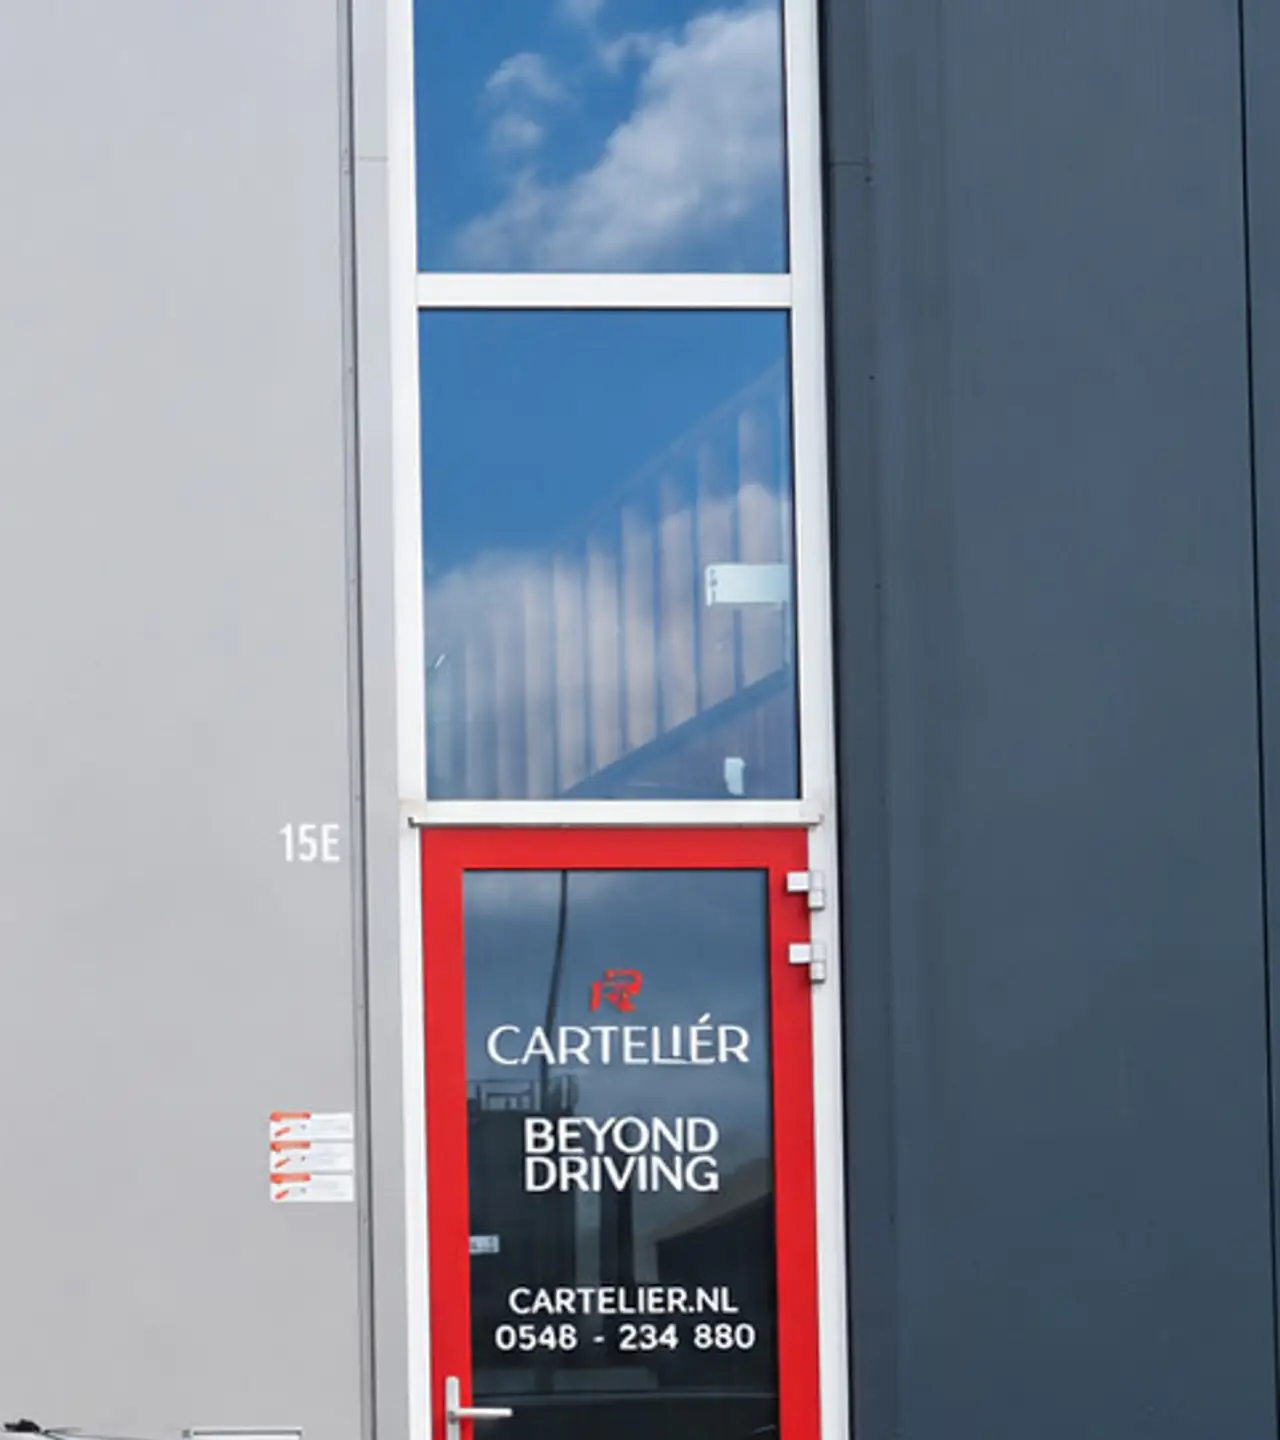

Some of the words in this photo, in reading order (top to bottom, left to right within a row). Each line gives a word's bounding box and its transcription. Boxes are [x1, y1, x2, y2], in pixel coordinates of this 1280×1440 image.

[278, 822, 341, 863] 15E
[524, 1116, 719, 1154] BEYOND
[525, 1155, 720, 1192] DRIVING
[508, 1286, 739, 1315] CARTELIER.NL
[494, 1323, 578, 1351] 0548
[618, 1323, 679, 1350] 234
[693, 1323, 756, 1350] 880
